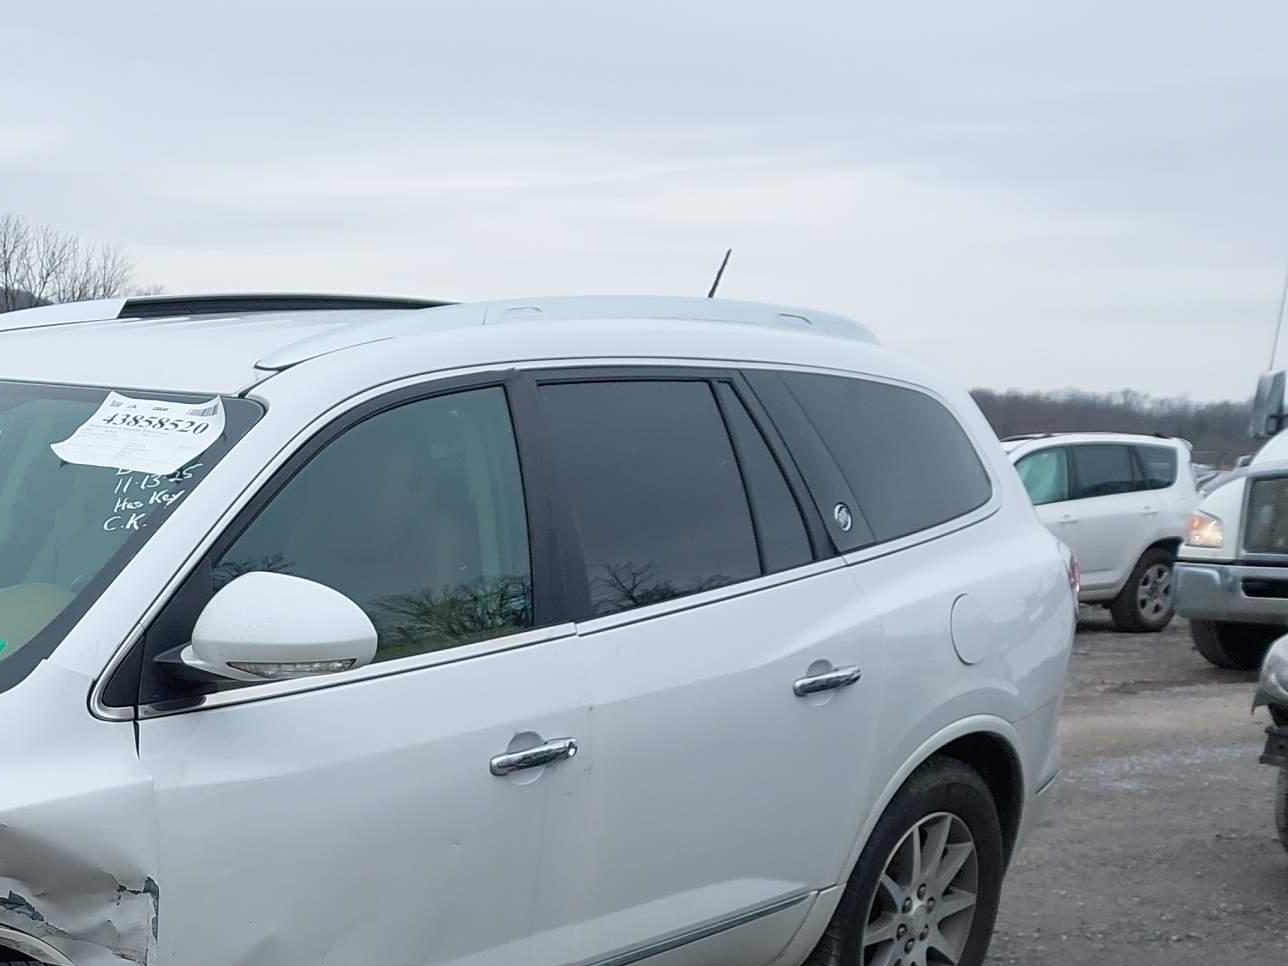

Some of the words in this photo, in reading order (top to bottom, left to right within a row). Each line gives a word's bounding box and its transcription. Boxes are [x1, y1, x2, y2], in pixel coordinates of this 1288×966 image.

[102, 413, 210, 435] 43858520
[114, 497, 144, 513] Has
[148, 489, 185, 507] Key
